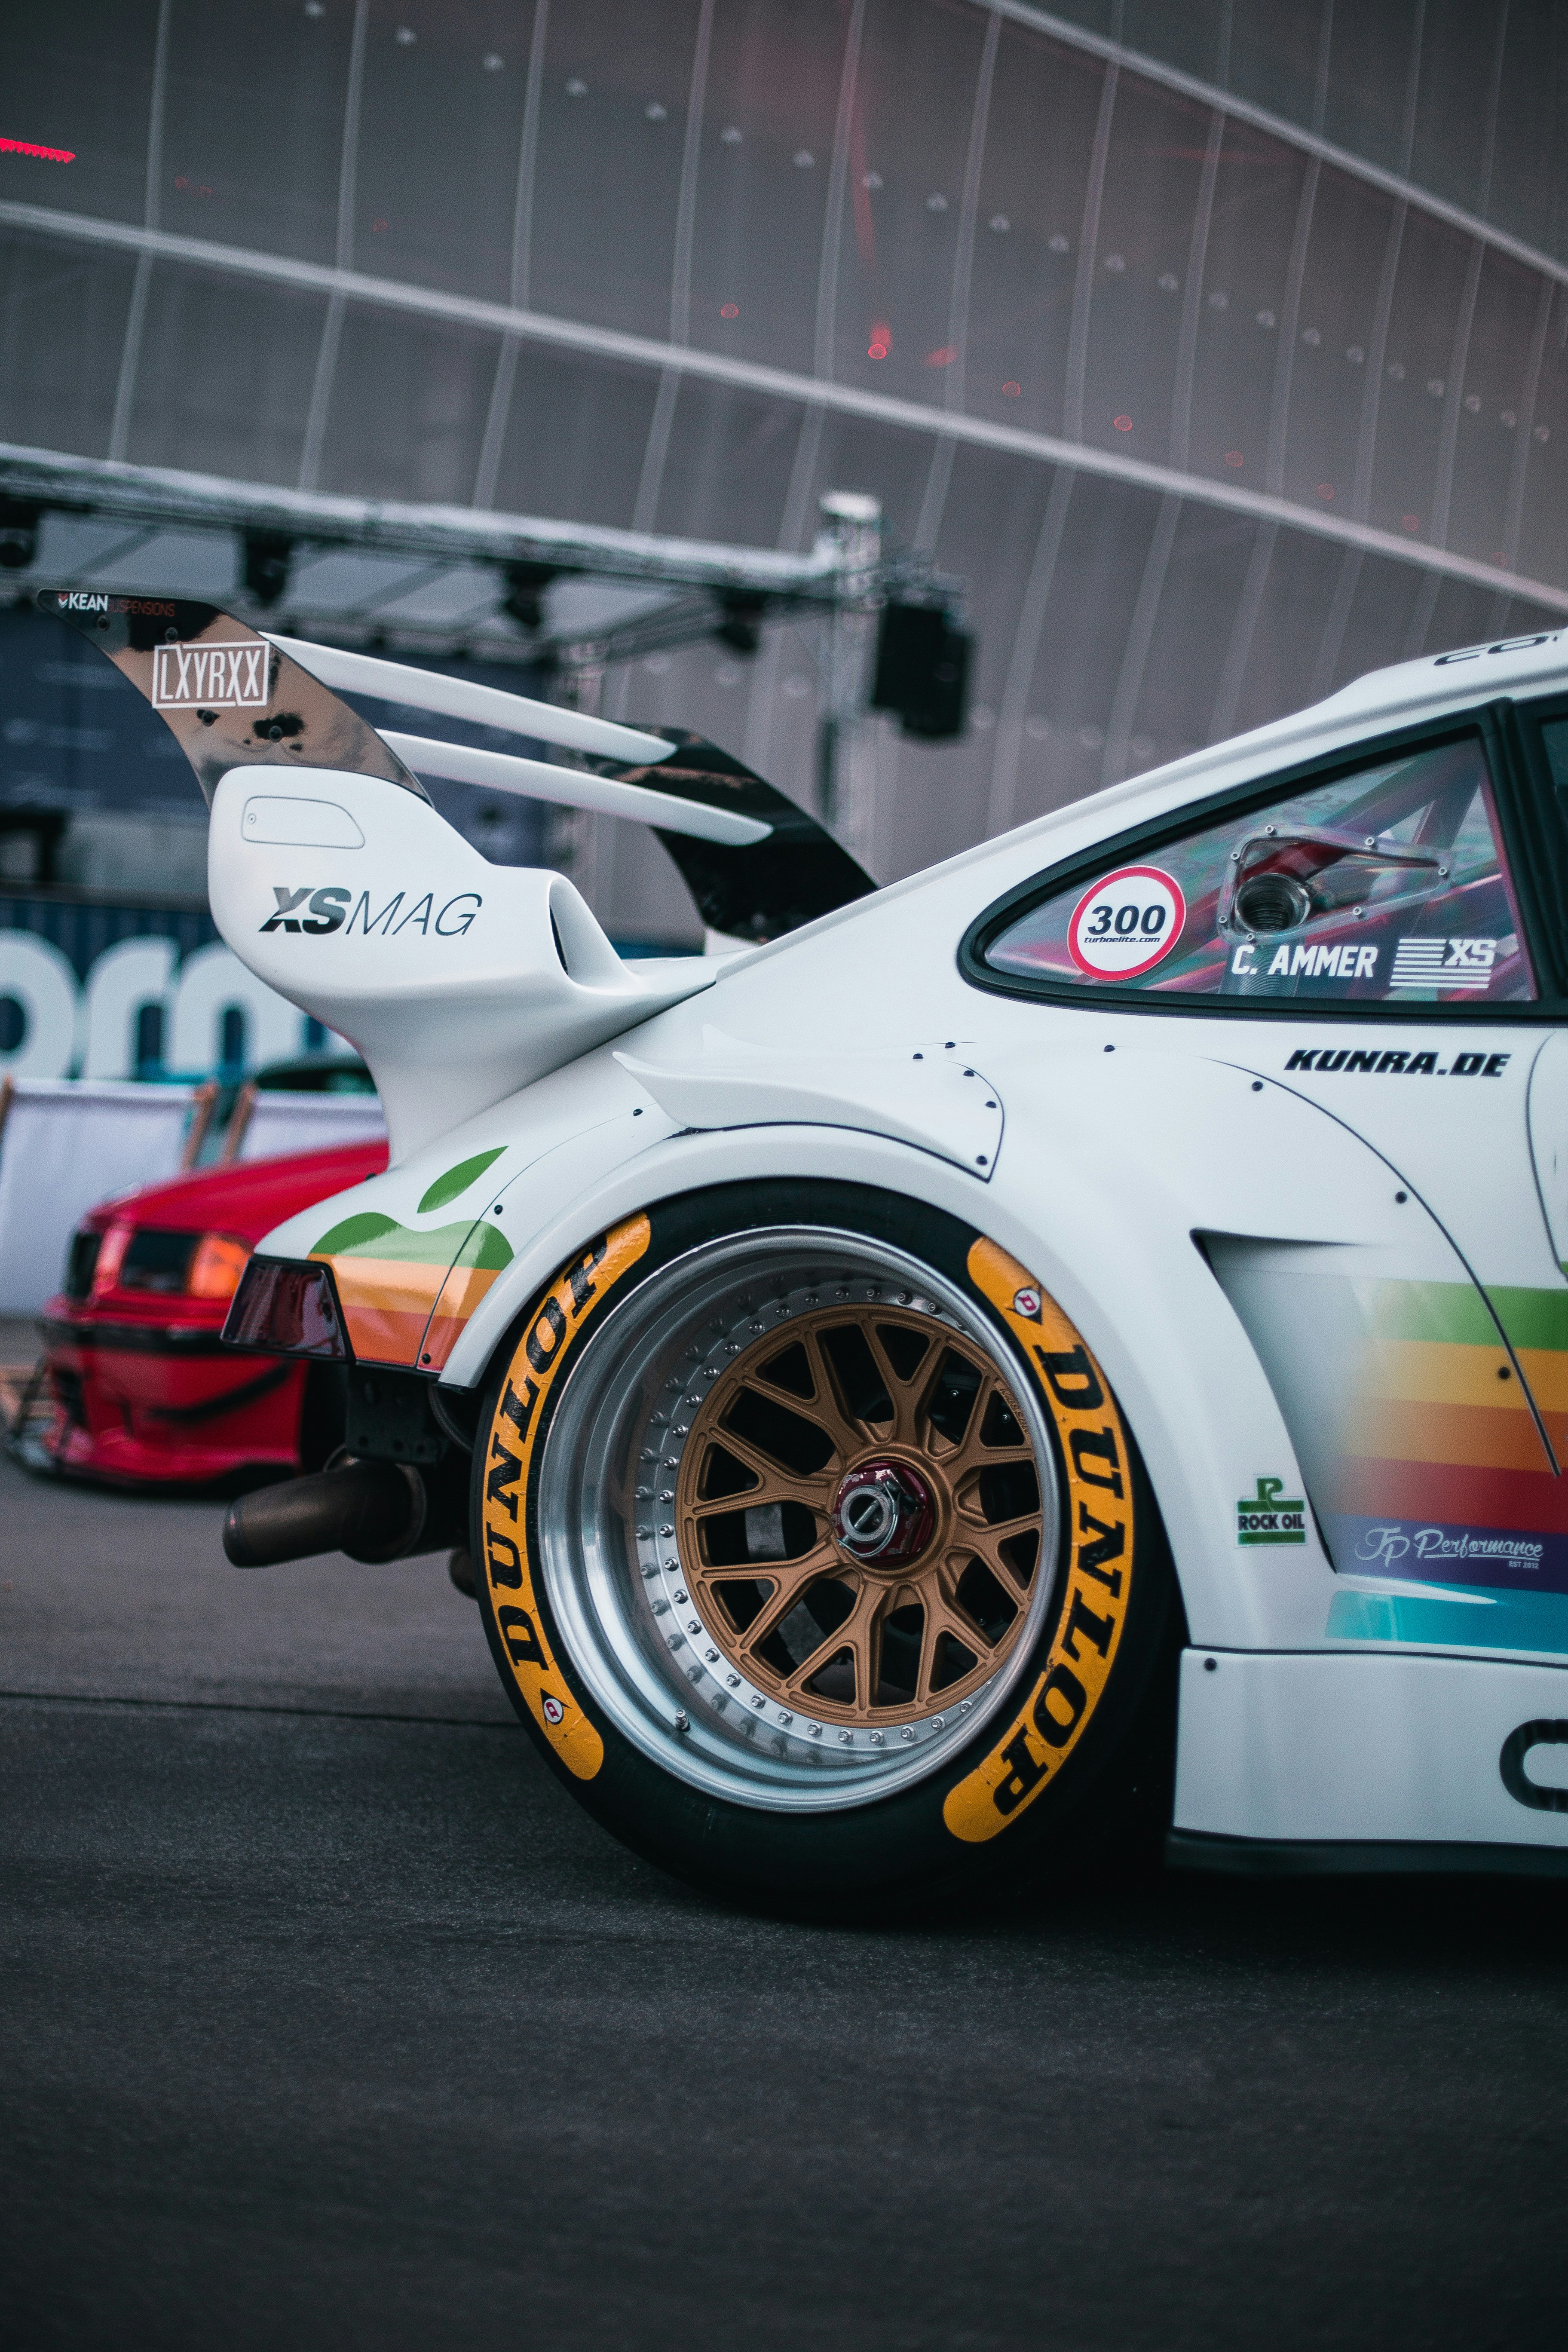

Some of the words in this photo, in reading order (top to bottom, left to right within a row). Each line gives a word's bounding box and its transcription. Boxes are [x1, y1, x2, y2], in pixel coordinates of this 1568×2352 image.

[69, 593, 108, 611] KEAN
[160, 650, 261, 700] LXYRXX
[1087, 905, 1166, 935] 300
[1231, 945, 1257, 975] C.
[1267, 946, 1378, 978] AMMER
[1445, 939, 1497, 966] XS
[1283, 1049, 1512, 1078] KUNRA.DE
[486, 1231, 607, 1671] DUNLOP
[1238, 1514, 1279, 1531] ROCK
[1282, 1514, 1305, 1529] OIL
[1413, 1529, 1544, 1559] Performance
[994, 1343, 1127, 1817] DUNLOP
